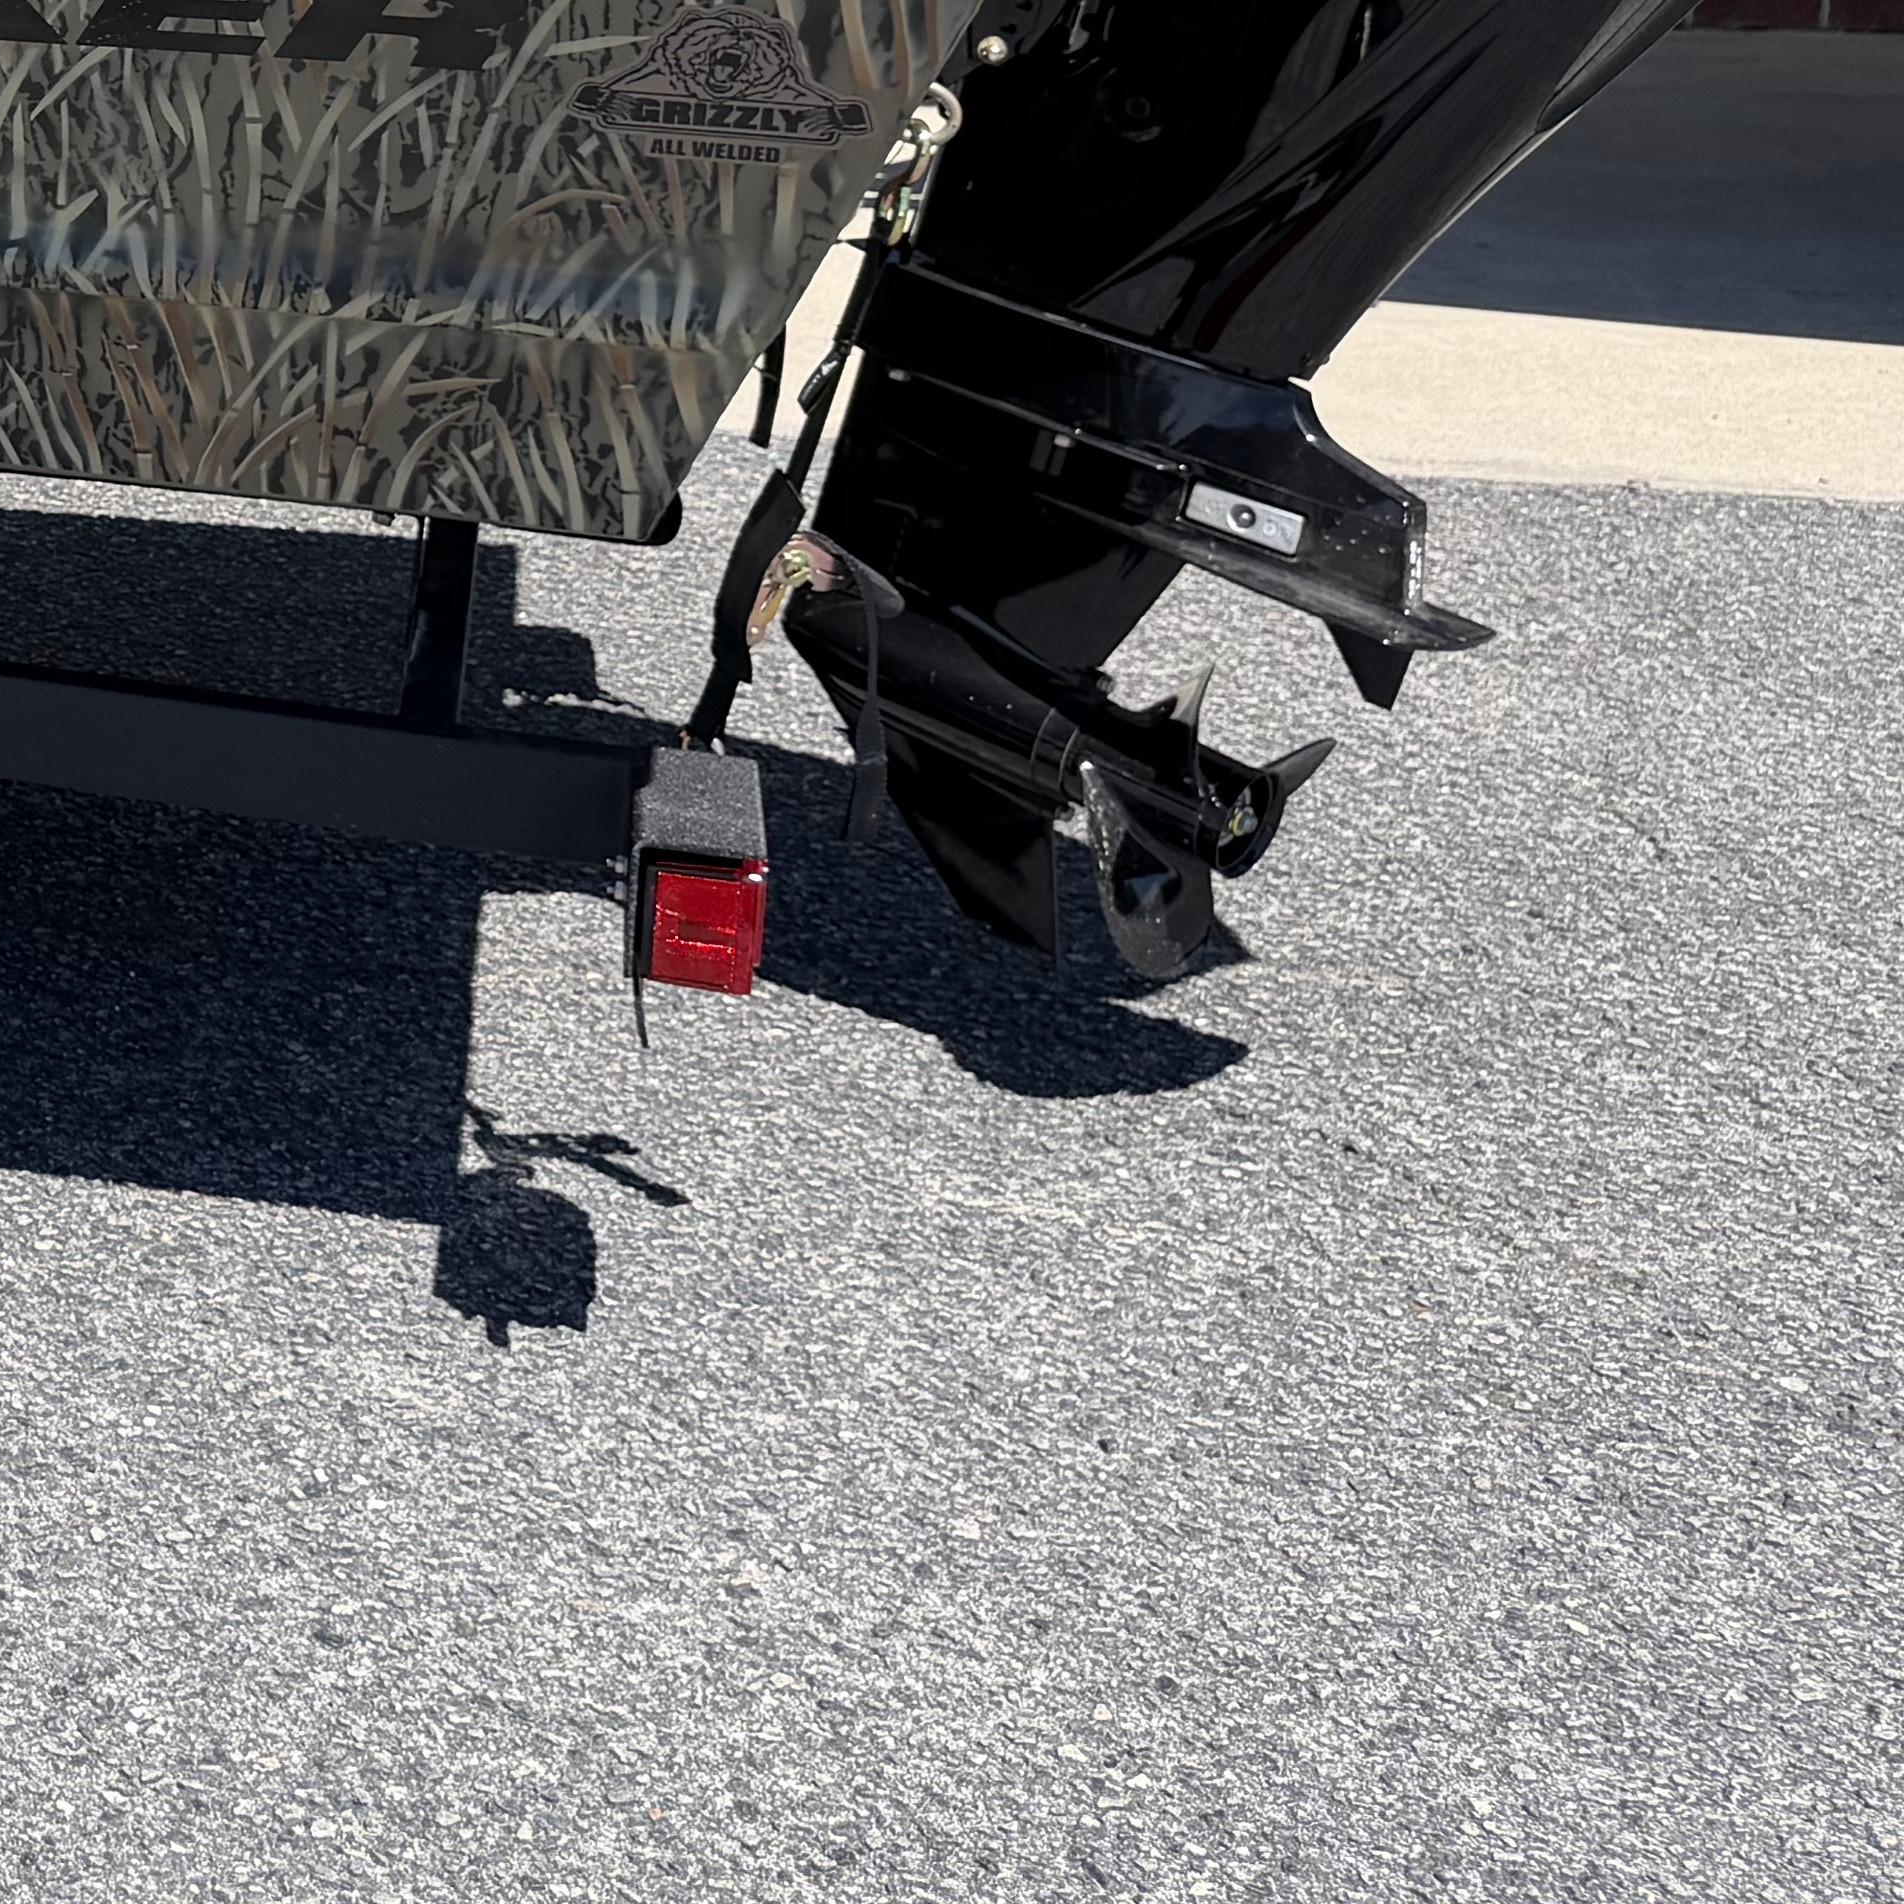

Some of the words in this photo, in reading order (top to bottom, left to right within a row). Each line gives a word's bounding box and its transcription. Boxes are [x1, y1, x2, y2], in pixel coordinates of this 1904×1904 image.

[637, 96, 804, 133] GRIZZLY
[650, 138, 685, 156] ALL
[692, 140, 781, 163] WELDED
